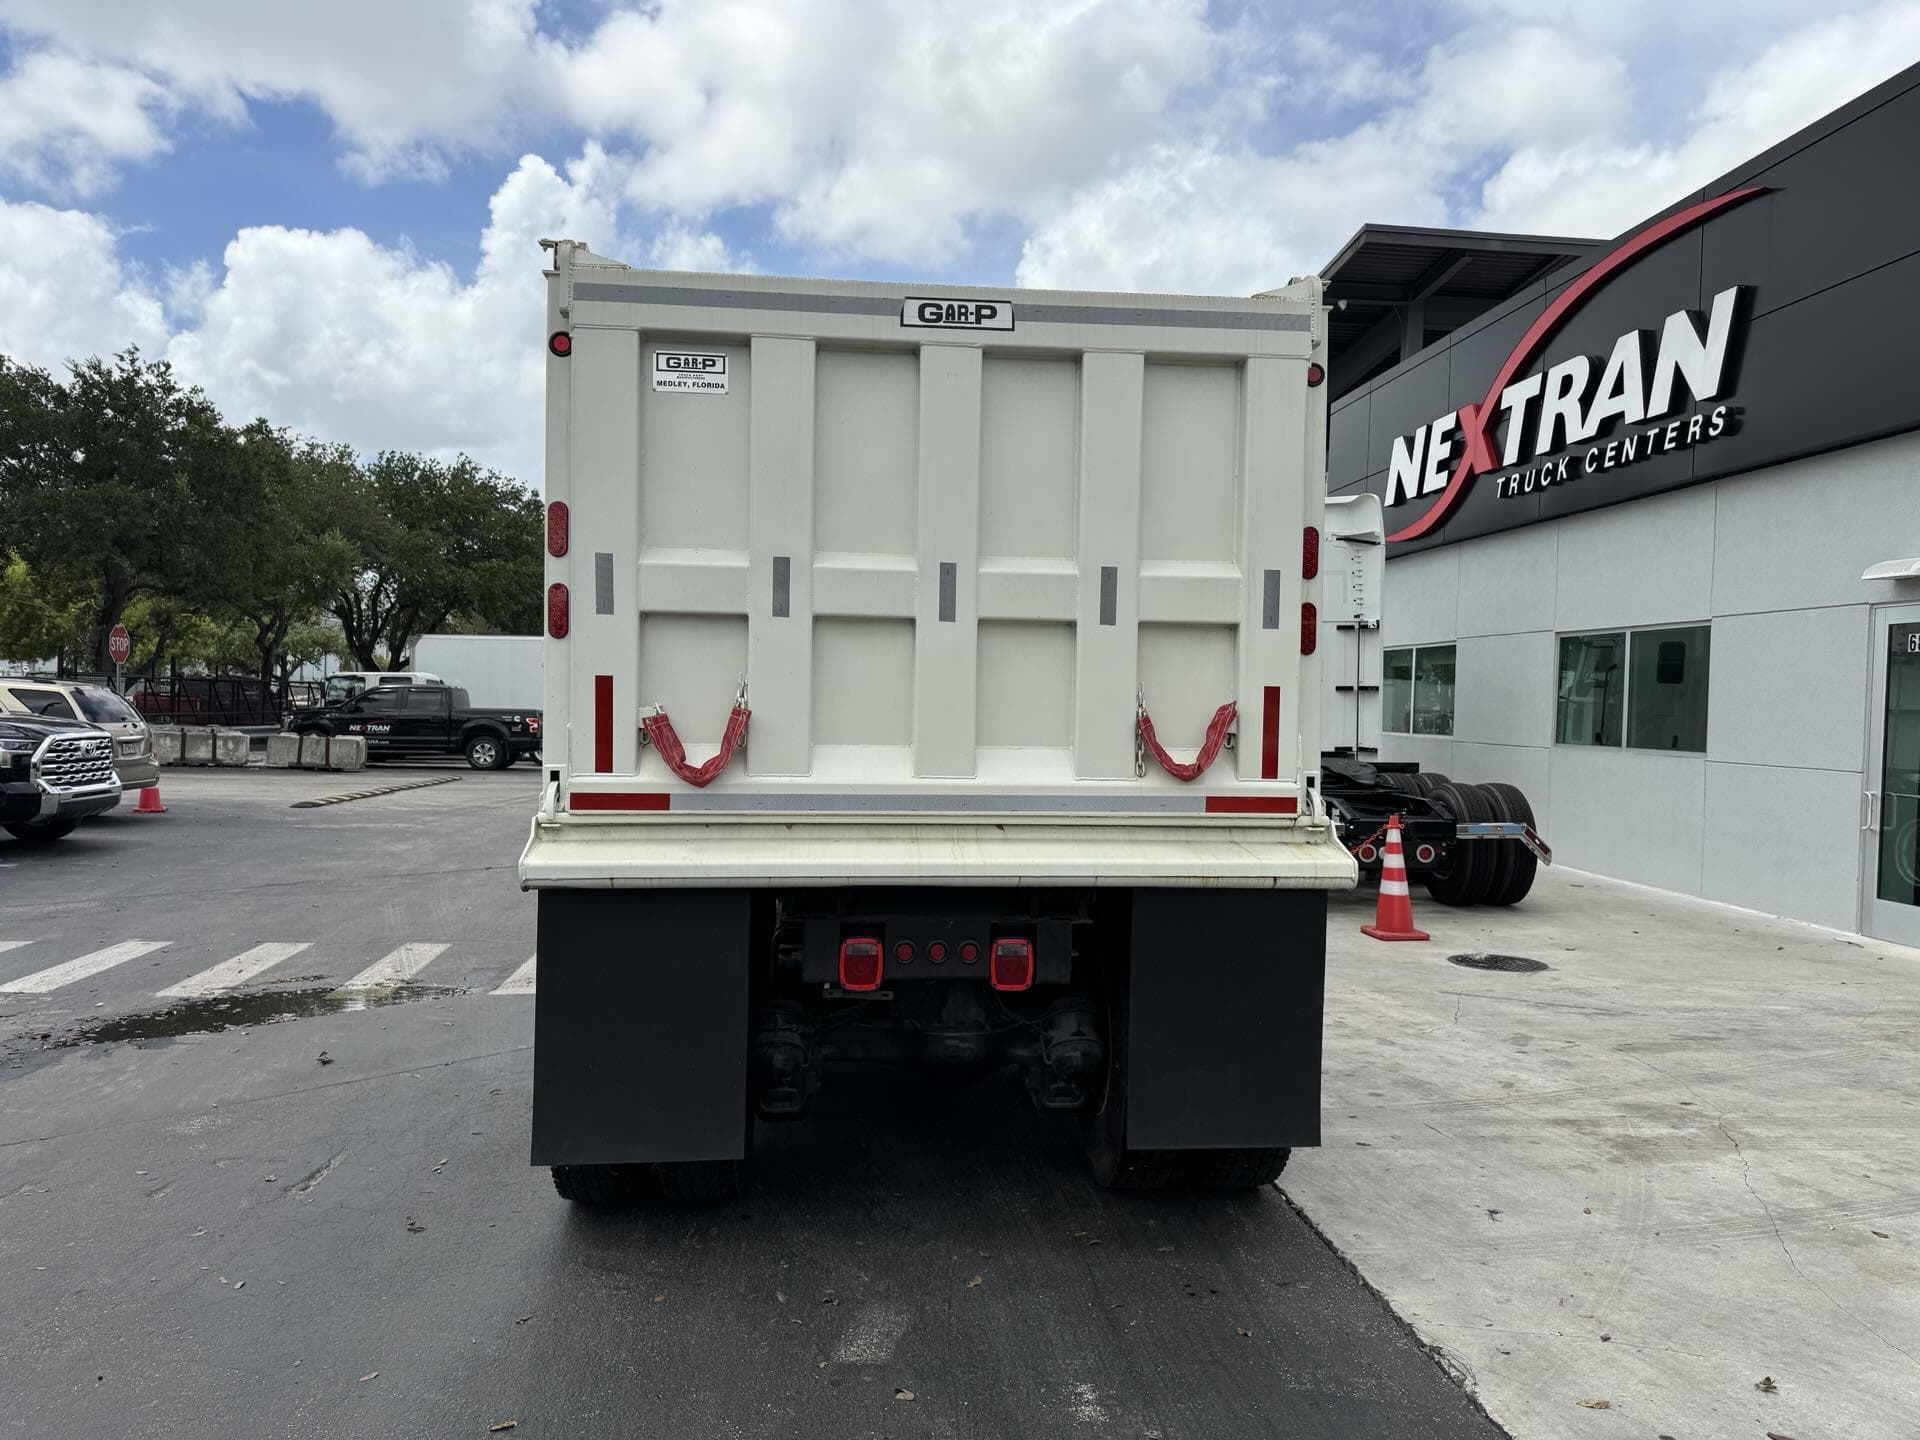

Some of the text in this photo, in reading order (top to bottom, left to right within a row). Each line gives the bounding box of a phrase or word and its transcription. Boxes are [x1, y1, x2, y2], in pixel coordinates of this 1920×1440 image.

[918, 302, 998, 325] GAR-P
[656, 380, 726, 390] MEDLEY, FLORIDA
[1384, 285, 1739, 507] NEXTRAN
[1496, 405, 1728, 498] TRUCK CENTERS
[111, 636, 129, 651] STOP
[1909, 634, 1920, 652] 6
[349, 723, 391, 732] NEXTRAN
